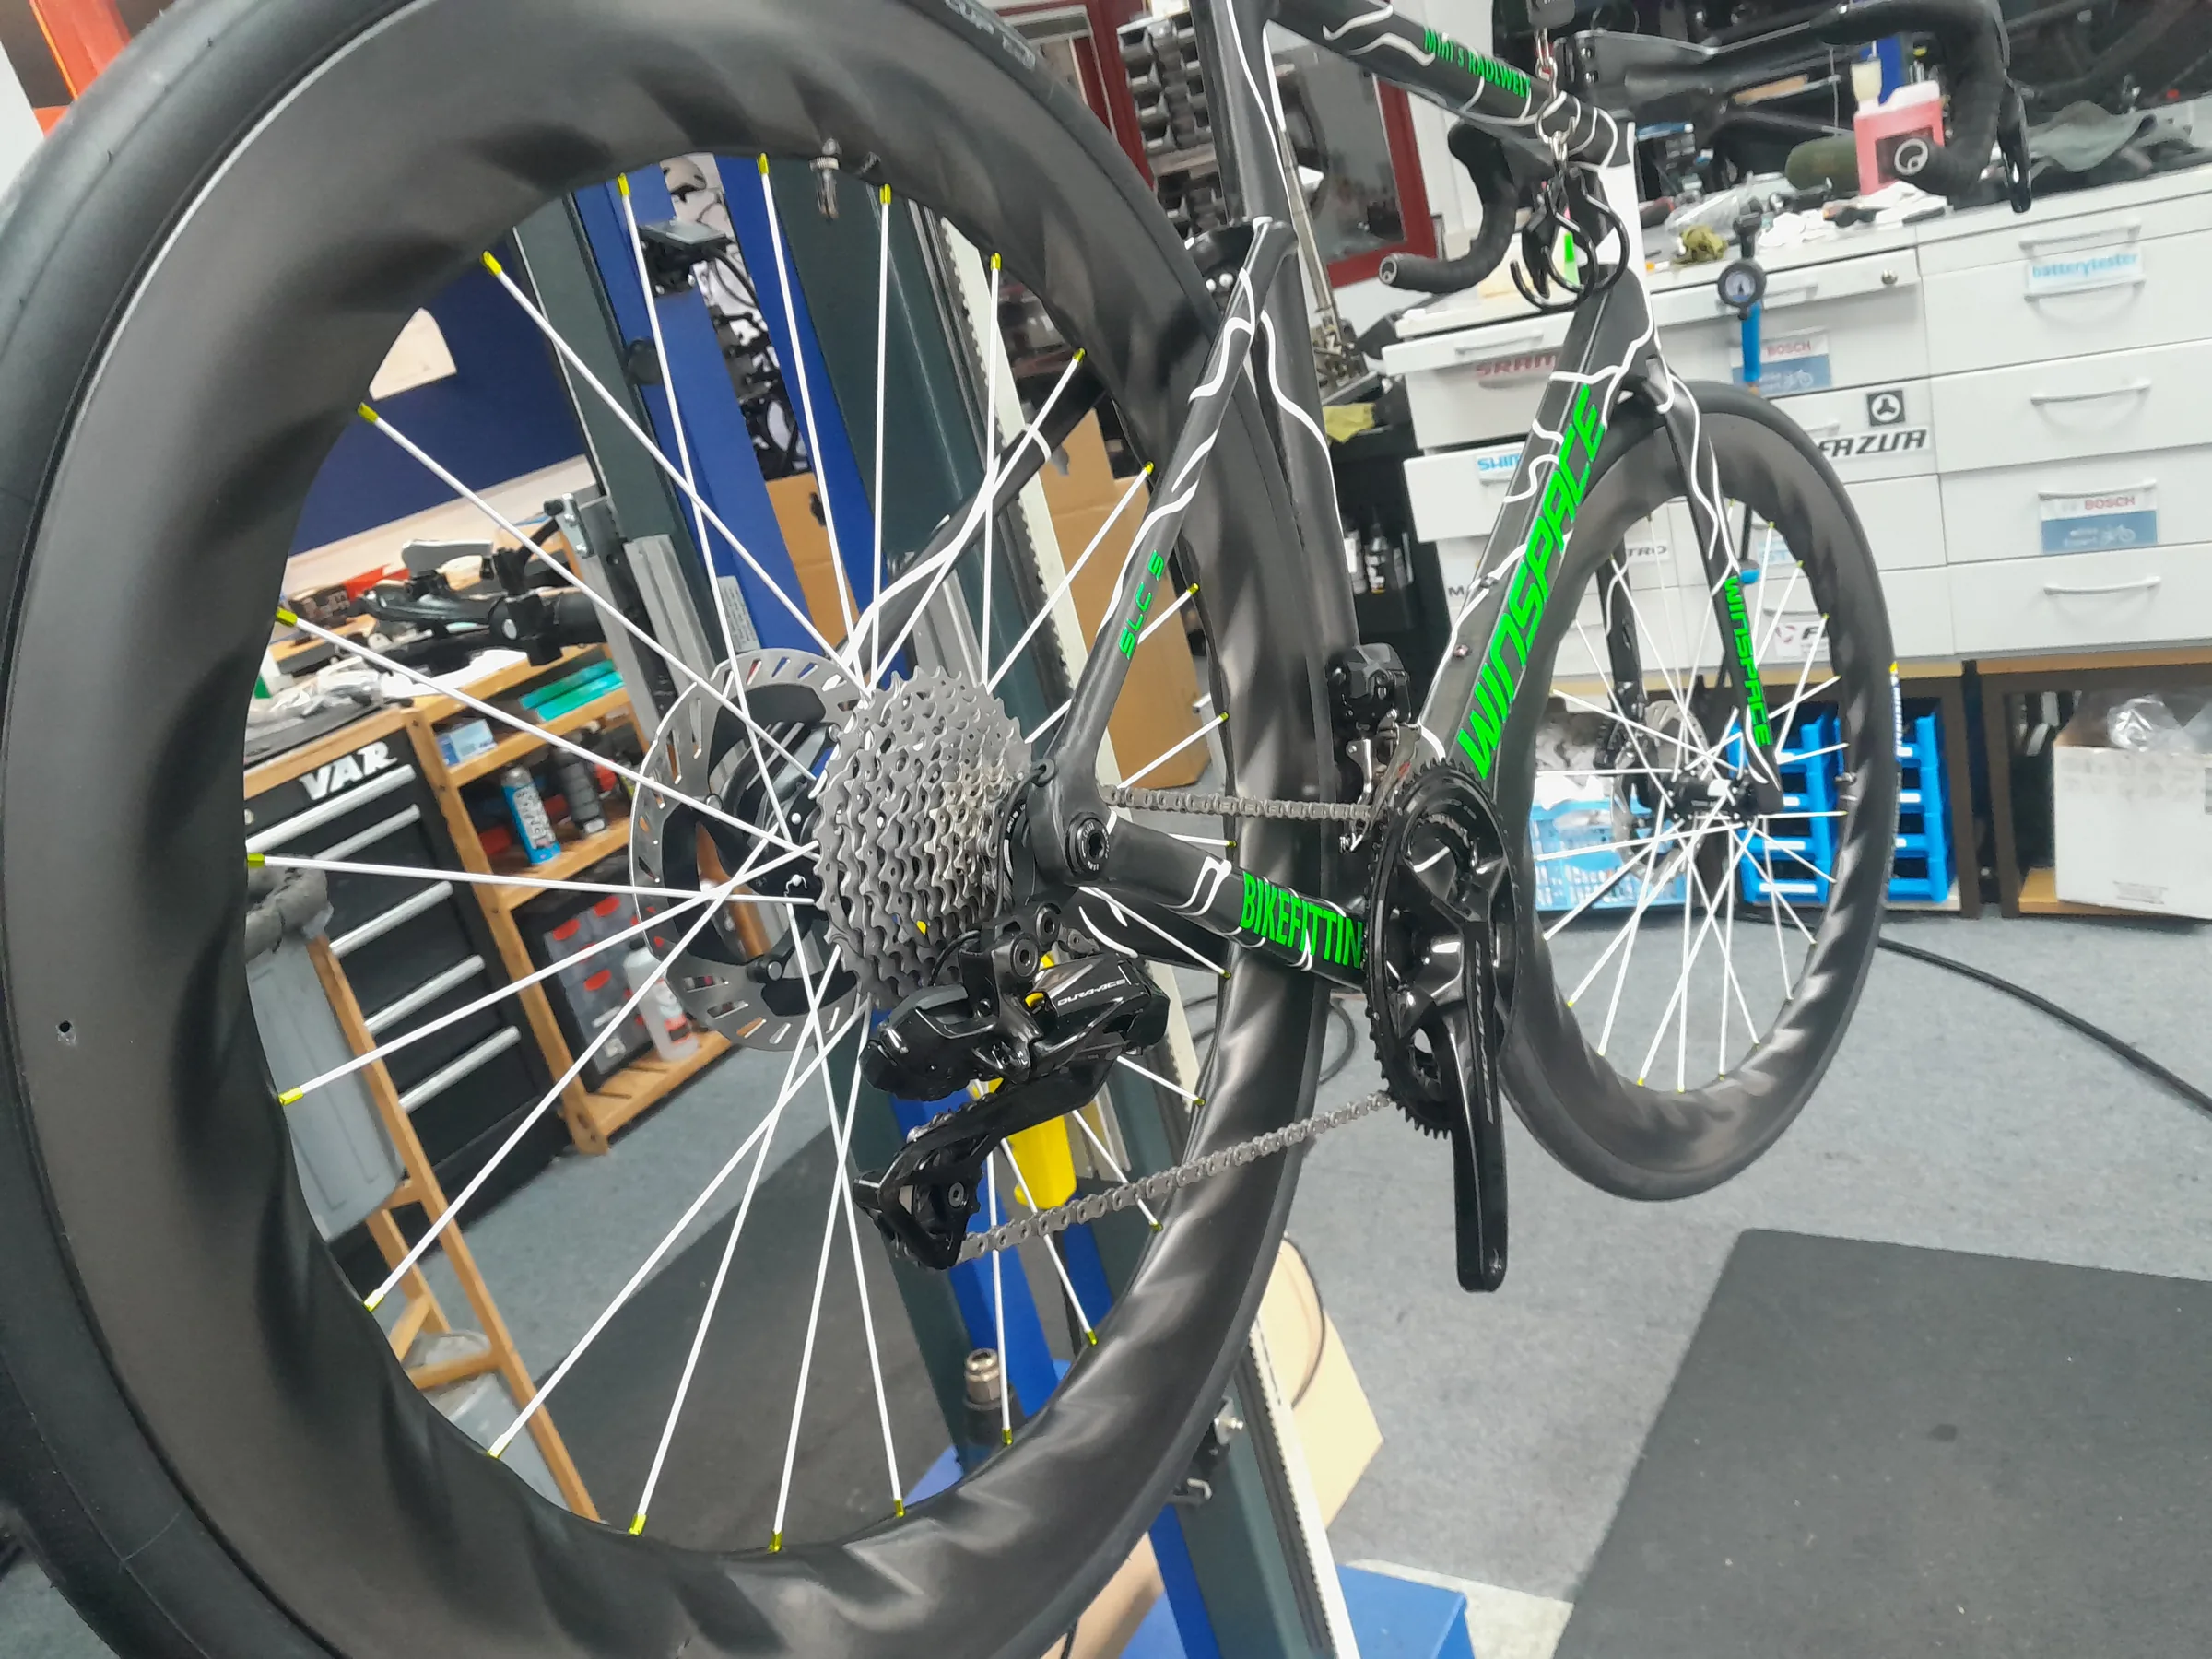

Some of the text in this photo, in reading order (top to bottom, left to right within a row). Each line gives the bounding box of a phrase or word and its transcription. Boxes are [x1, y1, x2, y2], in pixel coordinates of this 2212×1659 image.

[1467, 50, 1532, 100] RADLWELT
[2084, 495, 2136, 510] BOSCH
[1457, 383, 1606, 781] WINSPACE
[1118, 582, 1153, 660] SLC
[1724, 575, 1772, 747] WINSPACE
[298, 740, 398, 801] VAR
[1239, 870, 1364, 969] BIKEFITTIN
[1057, 978, 1126, 1006] DURA-ACE
